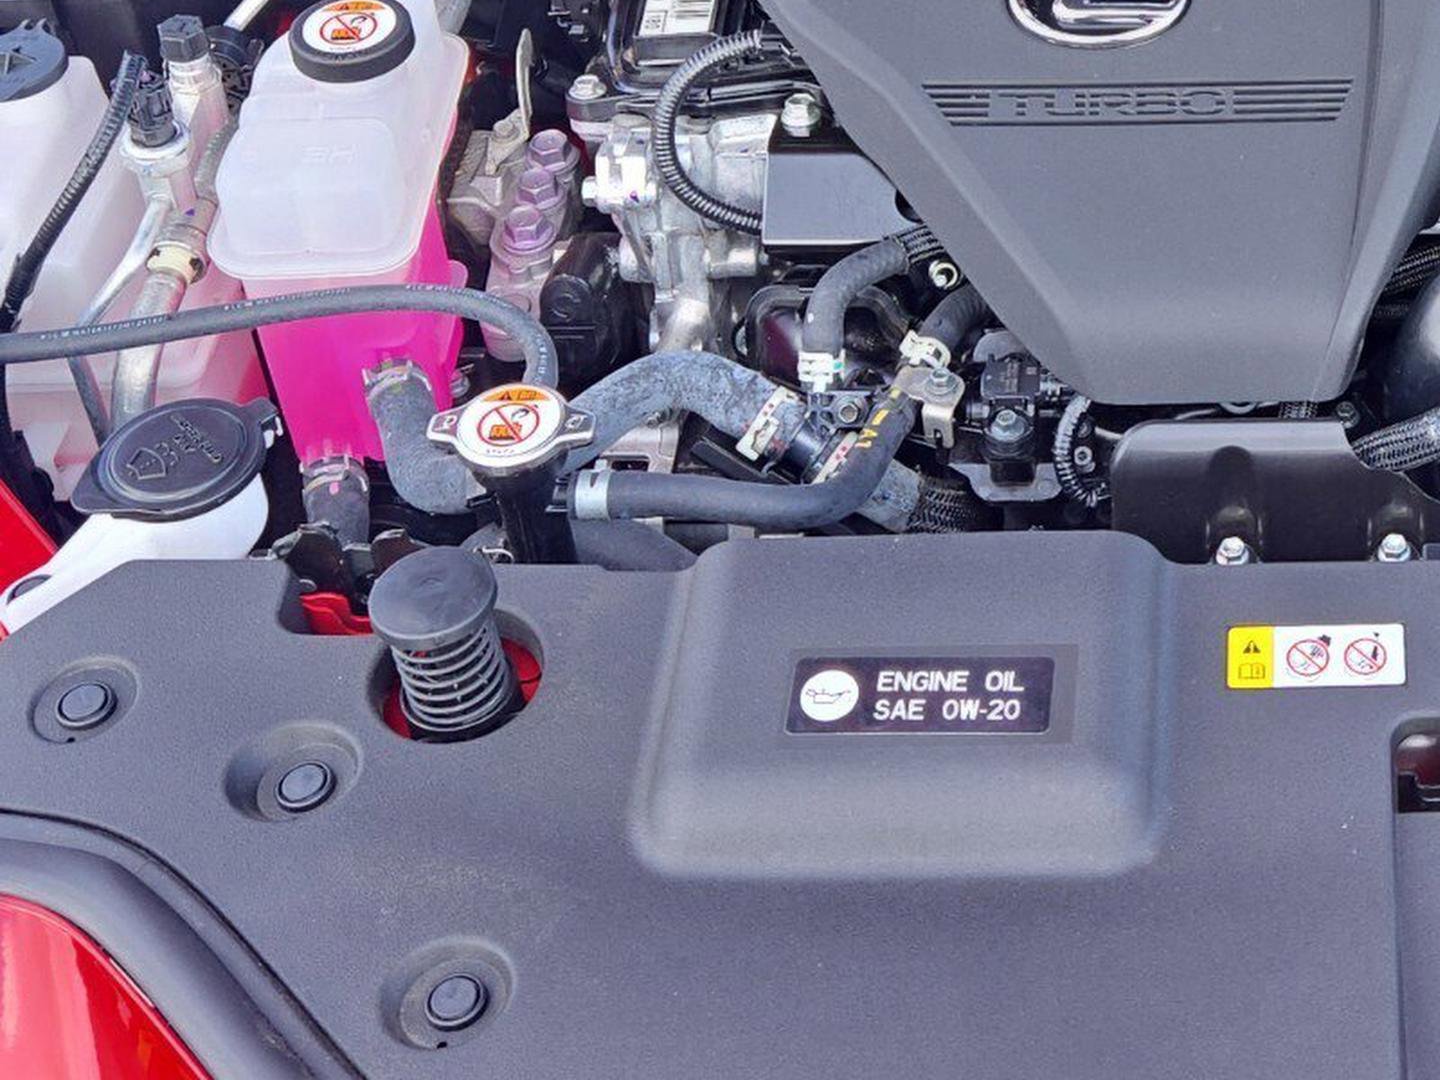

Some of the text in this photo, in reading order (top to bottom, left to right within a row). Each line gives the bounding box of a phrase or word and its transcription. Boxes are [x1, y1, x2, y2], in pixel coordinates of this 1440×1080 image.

[994, 90, 1229, 116] TURBO
[876, 670, 1025, 693] ENGINE OIL
[872, 698, 1022, 721] SAE 0W-20
